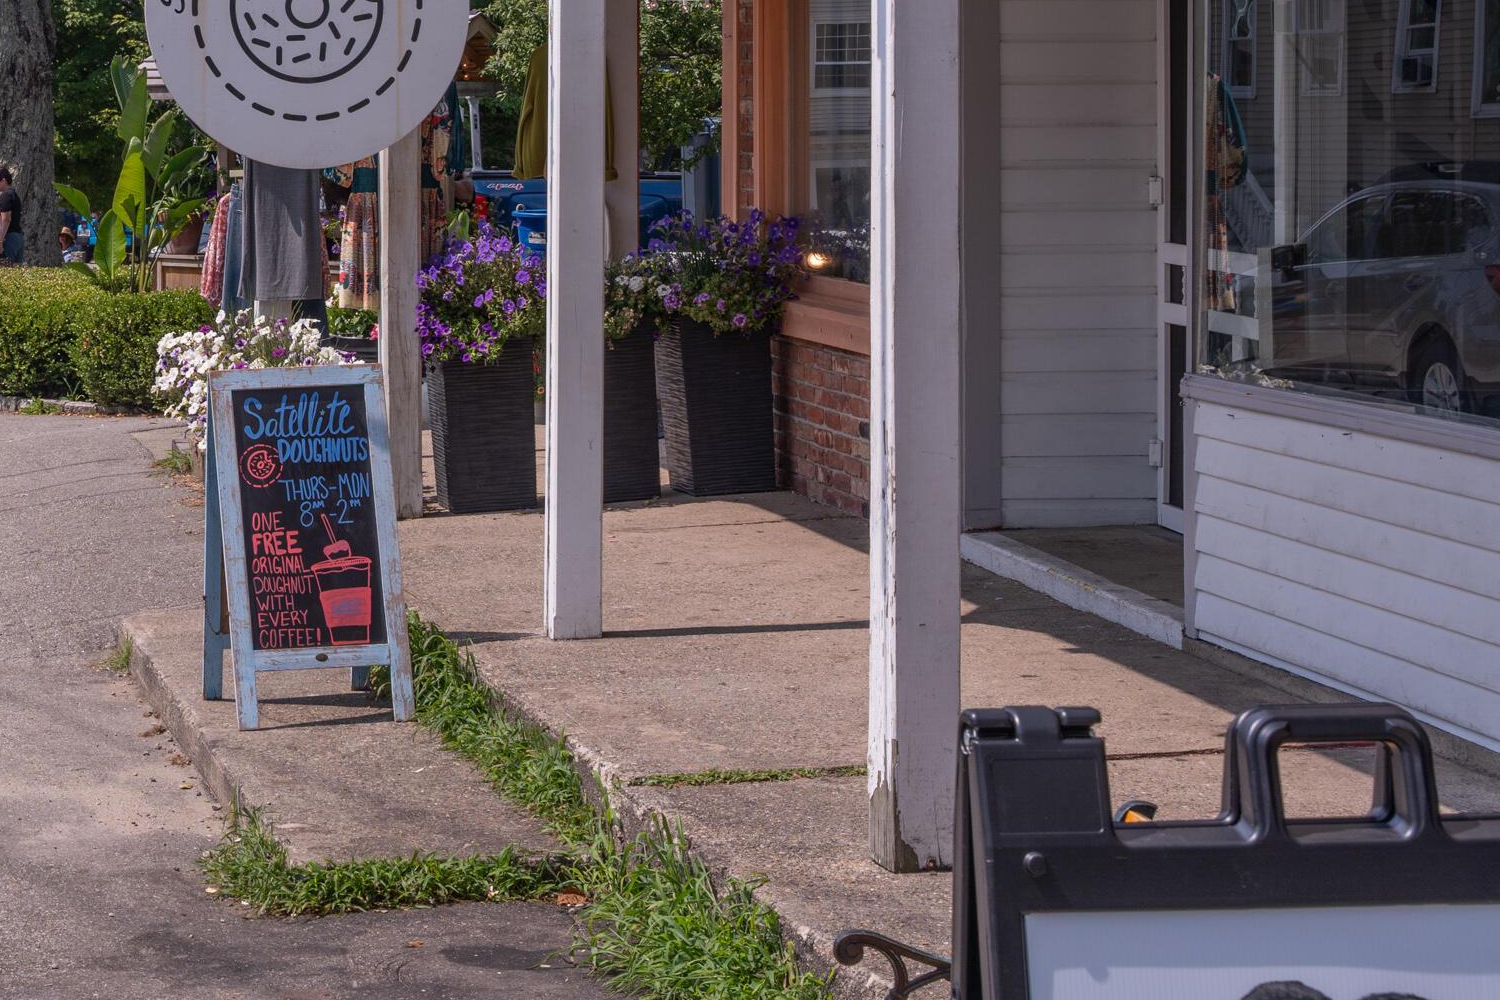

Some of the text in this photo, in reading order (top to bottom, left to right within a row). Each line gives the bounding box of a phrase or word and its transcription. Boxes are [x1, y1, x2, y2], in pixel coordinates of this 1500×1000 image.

[243, 391, 355, 440] Satellite
[277, 437, 368, 464] DOUGHNUTS
[252, 511, 285, 532] ONE
[252, 530, 303, 555] FREE
[252, 554, 315, 574] ORIGINAL
[253, 574, 315, 595] DOUGHNUT
[255, 595, 295, 612] WITH
[258, 610, 308, 628] EVERY
[259, 627, 322, 649] COFFEE!
